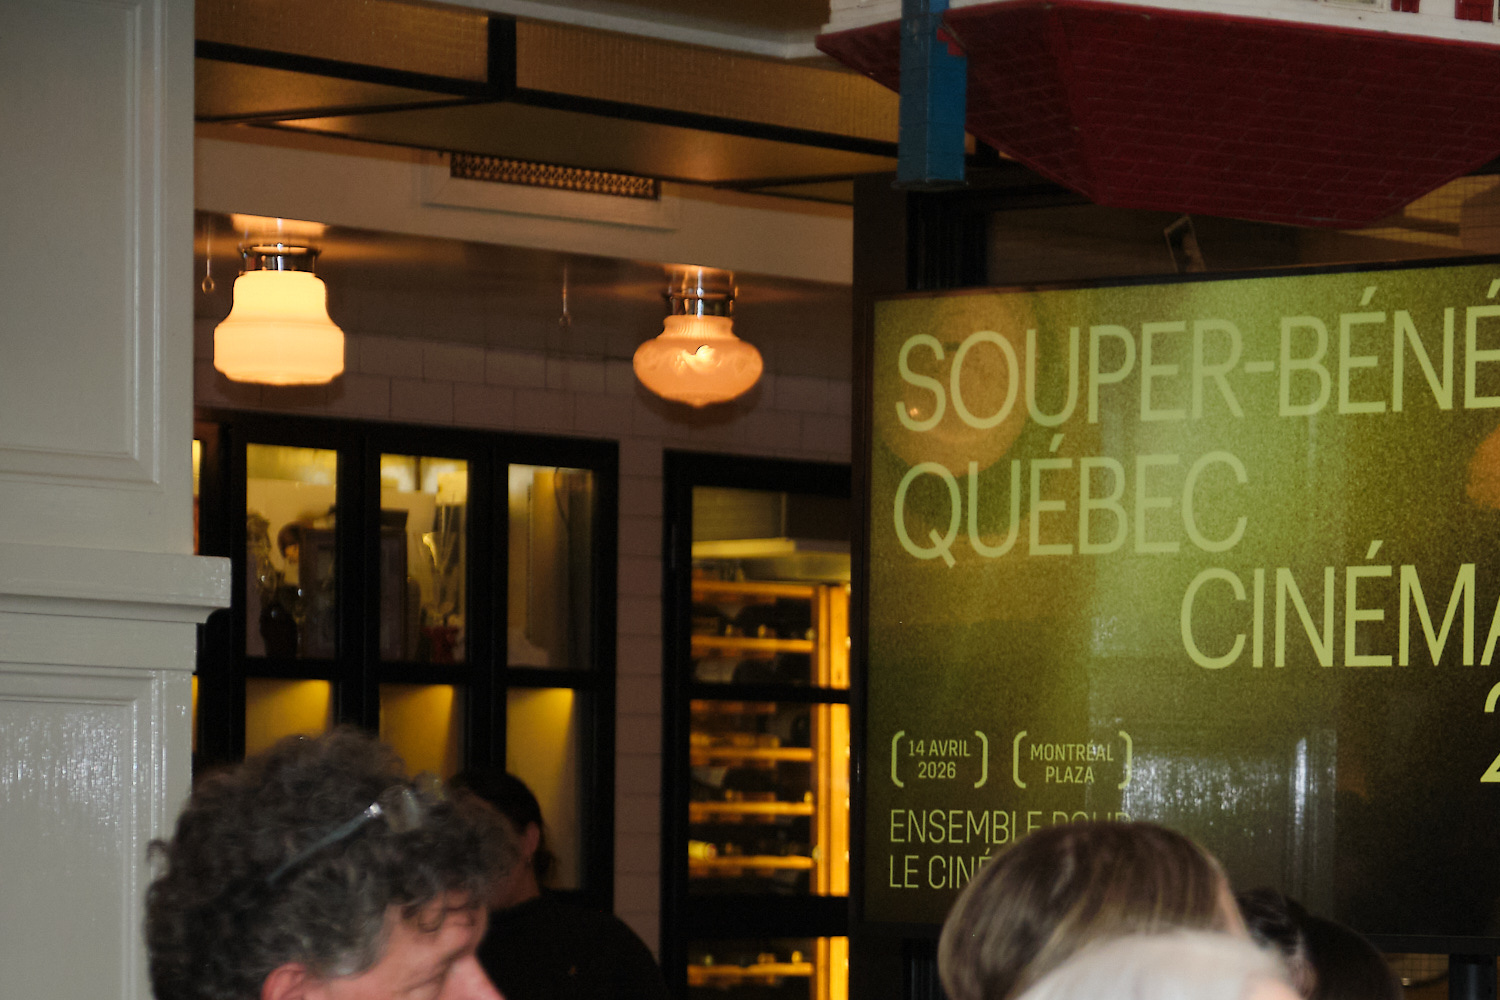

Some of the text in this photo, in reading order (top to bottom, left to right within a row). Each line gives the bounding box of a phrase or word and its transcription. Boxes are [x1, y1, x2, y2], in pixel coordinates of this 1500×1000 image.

[892, 434, 1249, 568] QUÉBEC
[908, 739, 971, 757] 14 AVRIL
[1030, 739, 1115, 763] MONTRÉAL
[917, 761, 957, 779] 2026
[1045, 766, 1095, 784] PLAZA
[889, 854, 919, 889] LE
